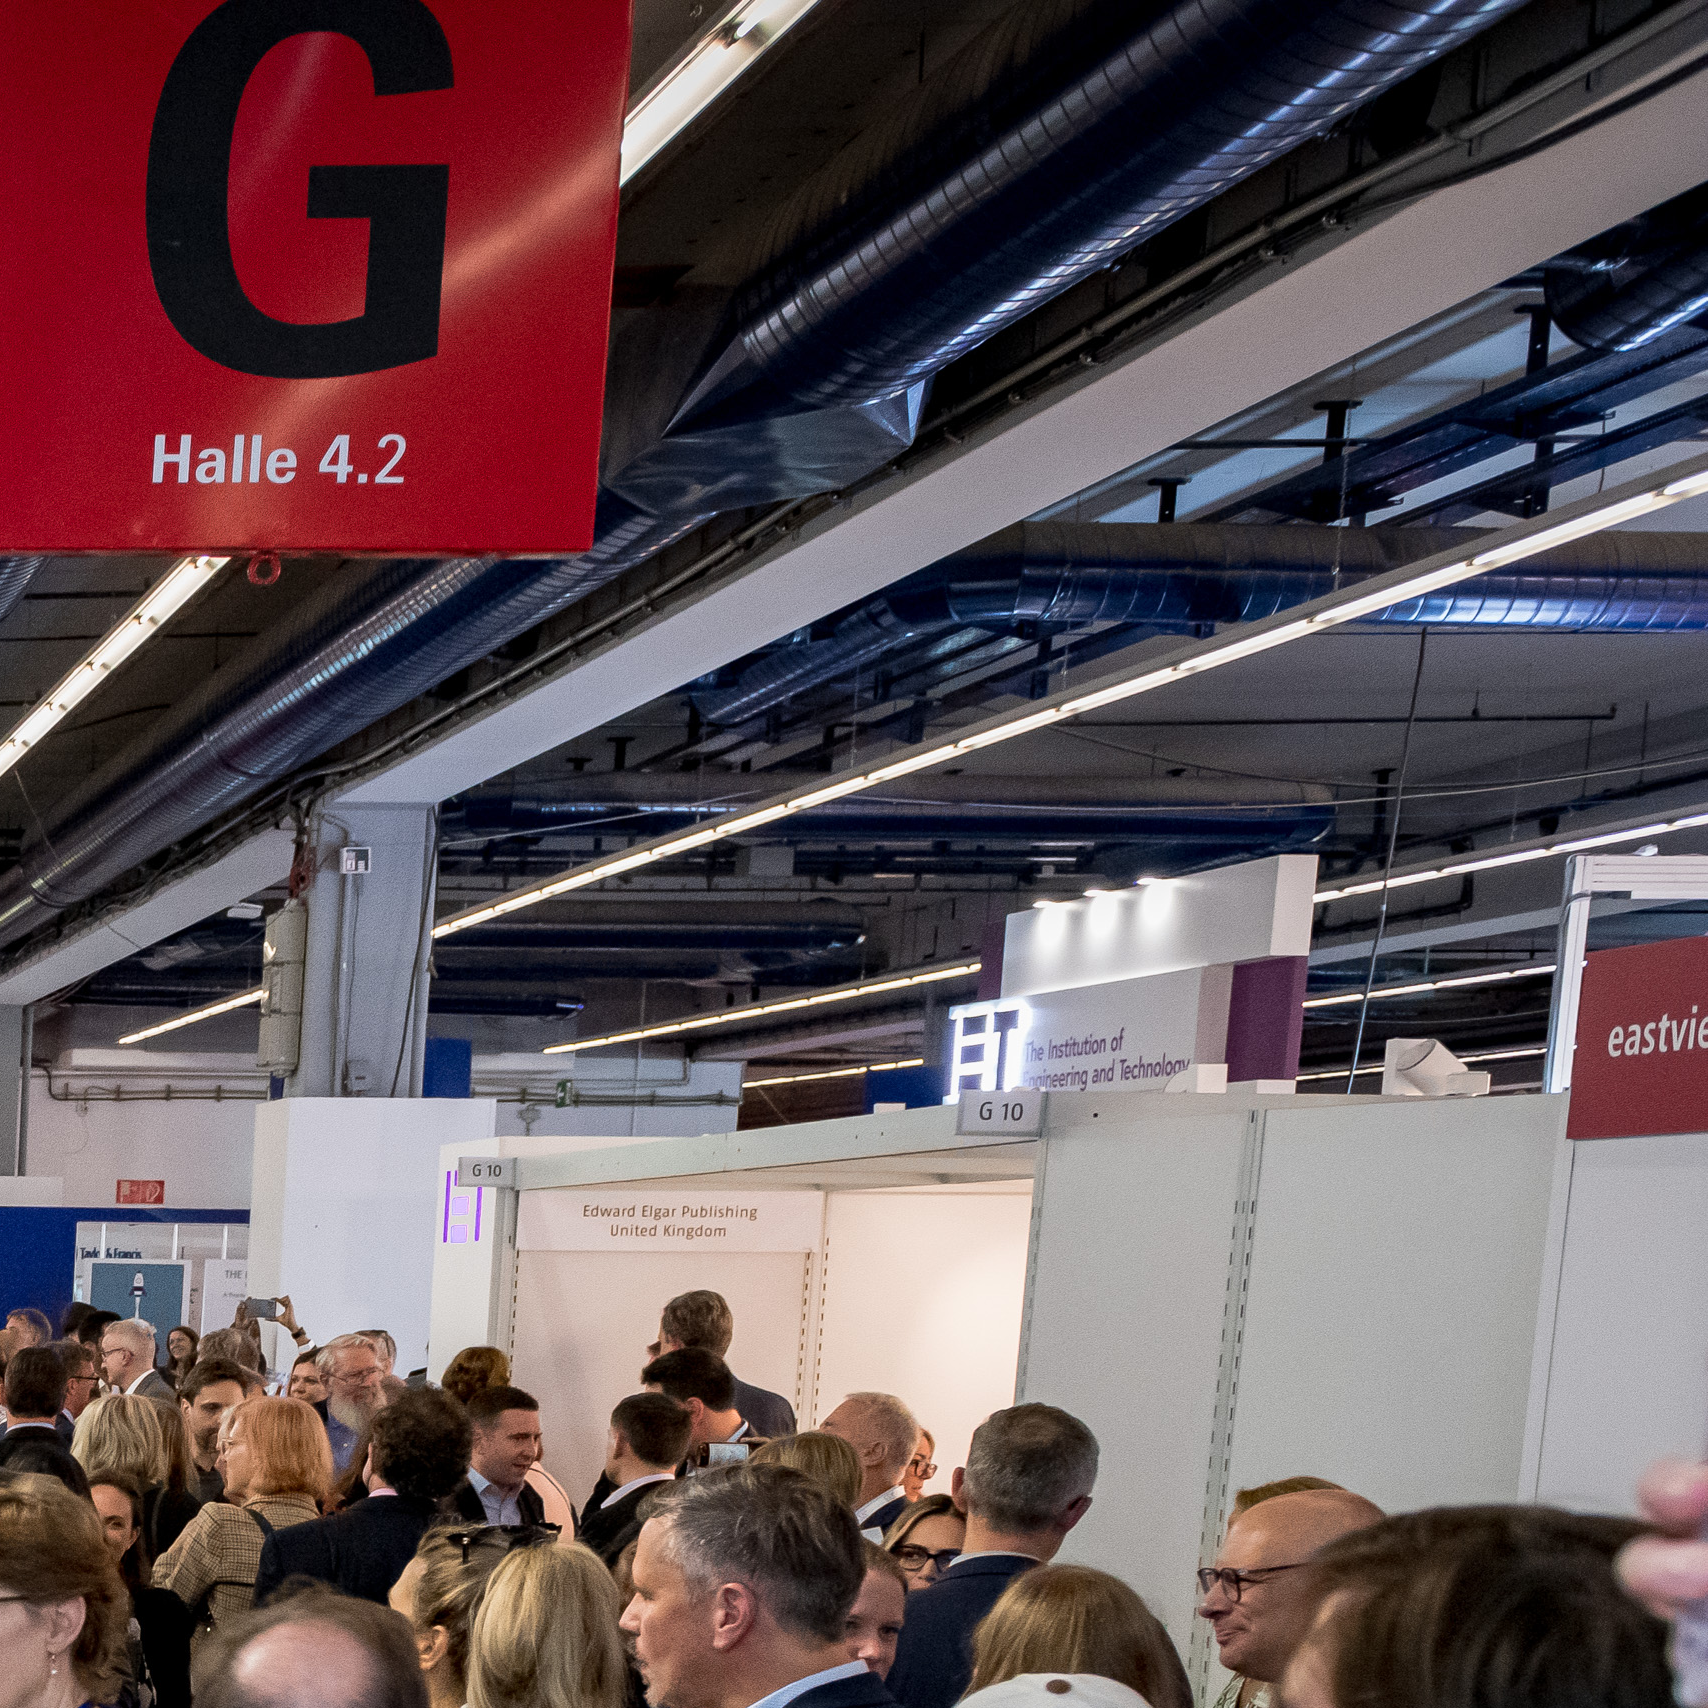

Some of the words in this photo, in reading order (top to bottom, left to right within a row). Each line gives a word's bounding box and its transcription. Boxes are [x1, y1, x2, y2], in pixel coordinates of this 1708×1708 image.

[145, 0, 454, 379] G
[151, 434, 297, 484] Halle
[319, 434, 407, 484] 4.2
[1025, 1040, 1044, 1062] The
[1048, 1034, 1106, 1060] Institution
[1110, 1027, 1125, 1051] of
[1092, 1058, 1115, 1083] and
[979, 1101, 993, 1121] G
[1002, 1102, 1024, 1122] 10
[472, 1164, 482, 1177] G
[487, 1165, 502, 1177] 10
[583, 1205, 636, 1218] Edward
[641, 1205, 677, 1220] Elgar
[682, 1205, 758, 1221] Publishing
[610, 1224, 657, 1237] United
[663, 1224, 727, 1240] Kingdom
